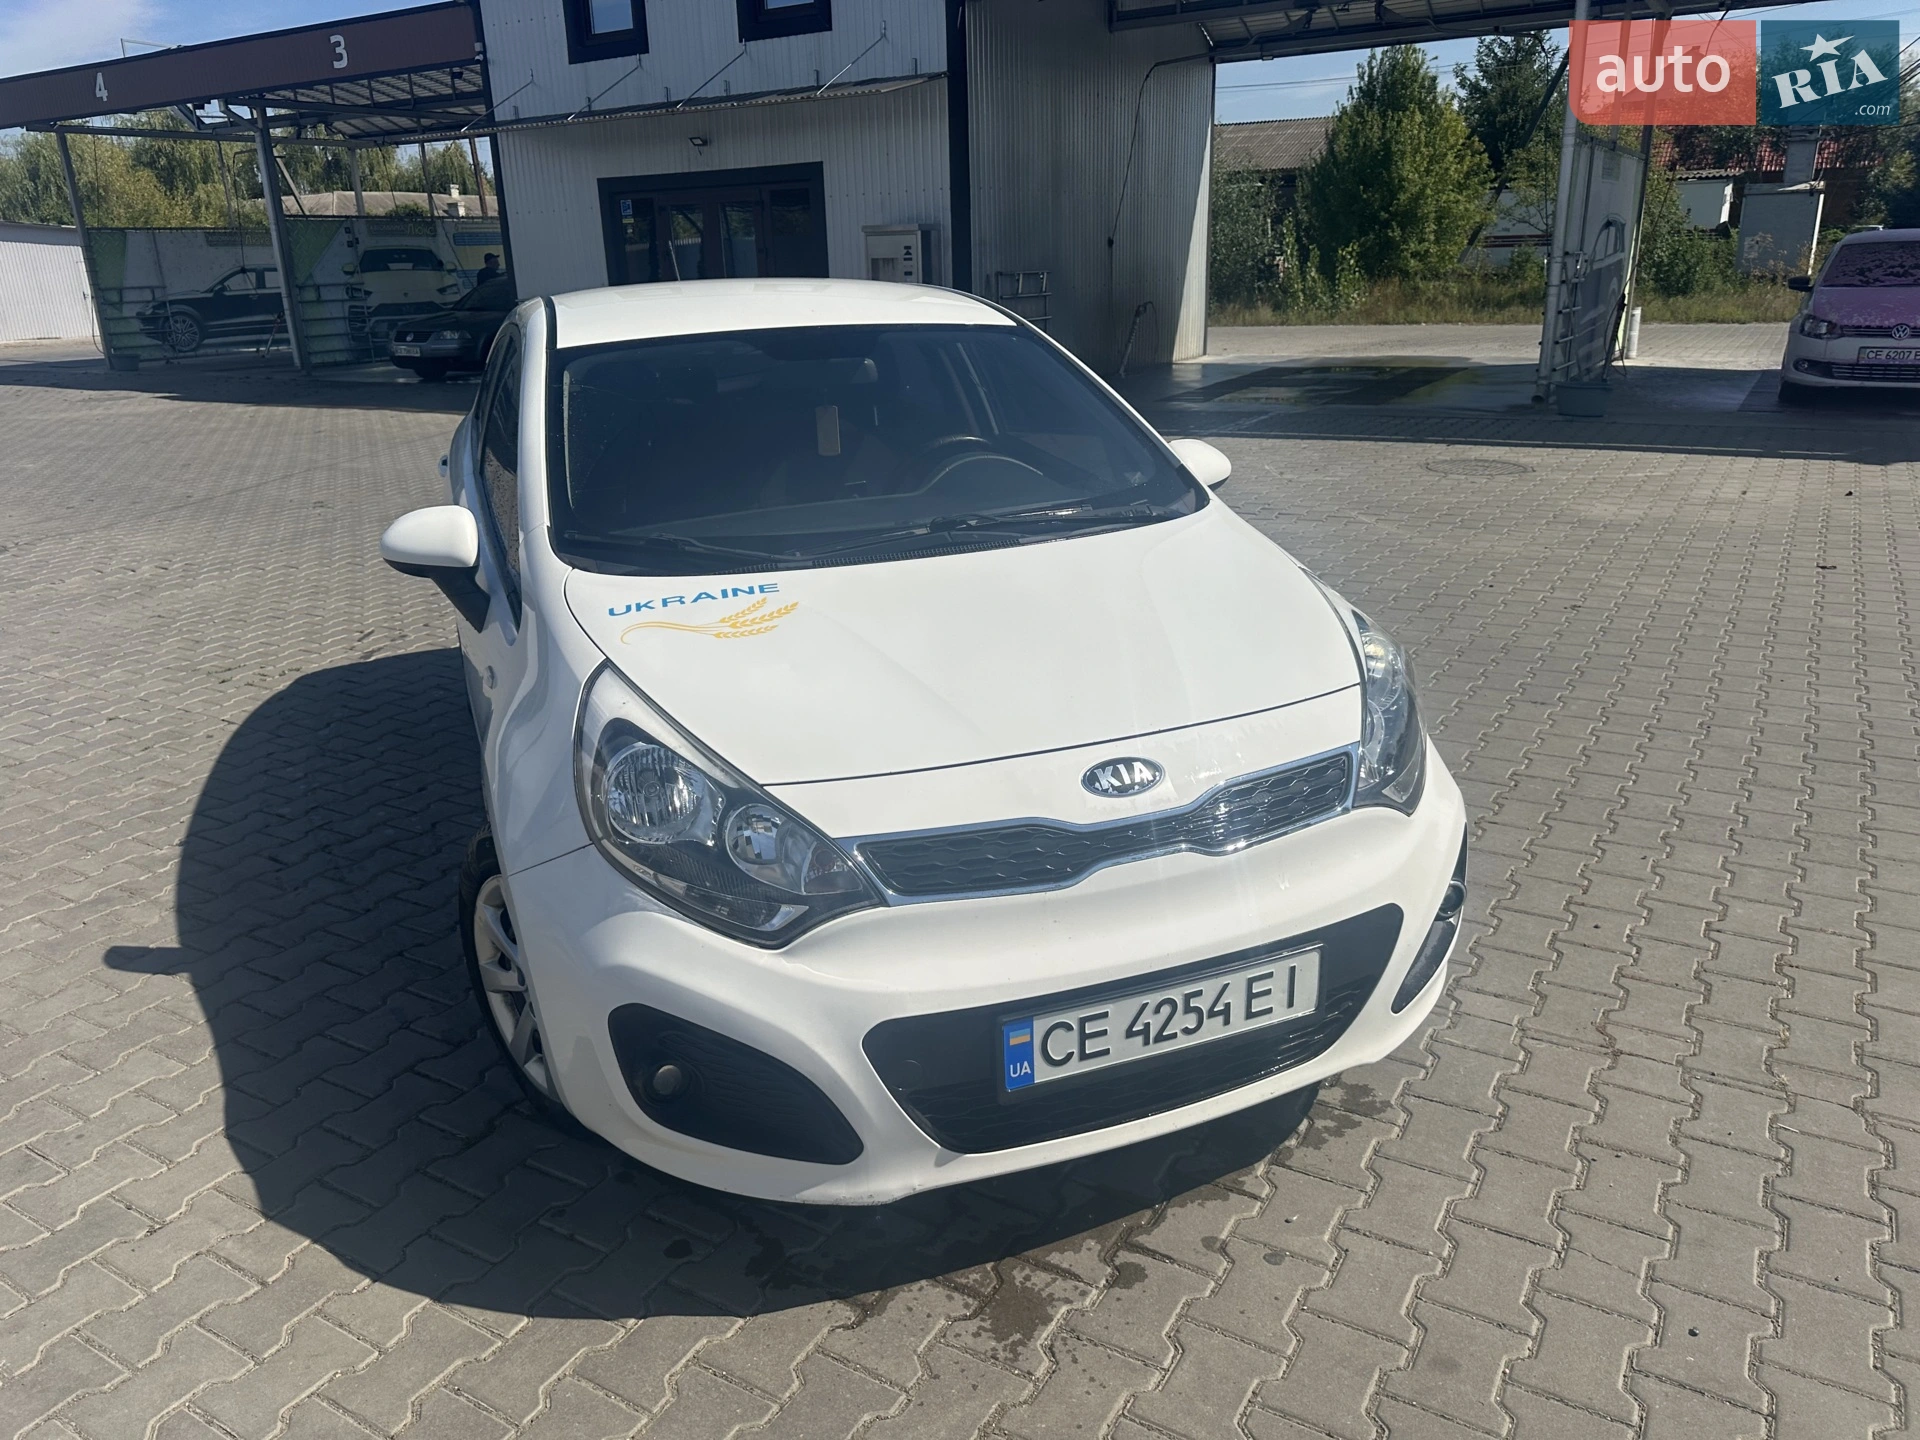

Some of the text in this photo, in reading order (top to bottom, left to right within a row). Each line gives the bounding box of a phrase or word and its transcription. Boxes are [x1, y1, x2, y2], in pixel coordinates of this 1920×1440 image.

[329, 34, 349, 69] 3
[95, 72, 108, 102] 4
[1866, 350, 1883, 360] CE
[1885, 350, 1912, 360] 6207
[608, 583, 780, 617] UKRAINE
[1093, 761, 1154, 790] KIA
[1040, 1010, 1112, 1067] CE
[1125, 981, 1232, 1047] 4254
[1010, 1060, 1032, 1078] UA
